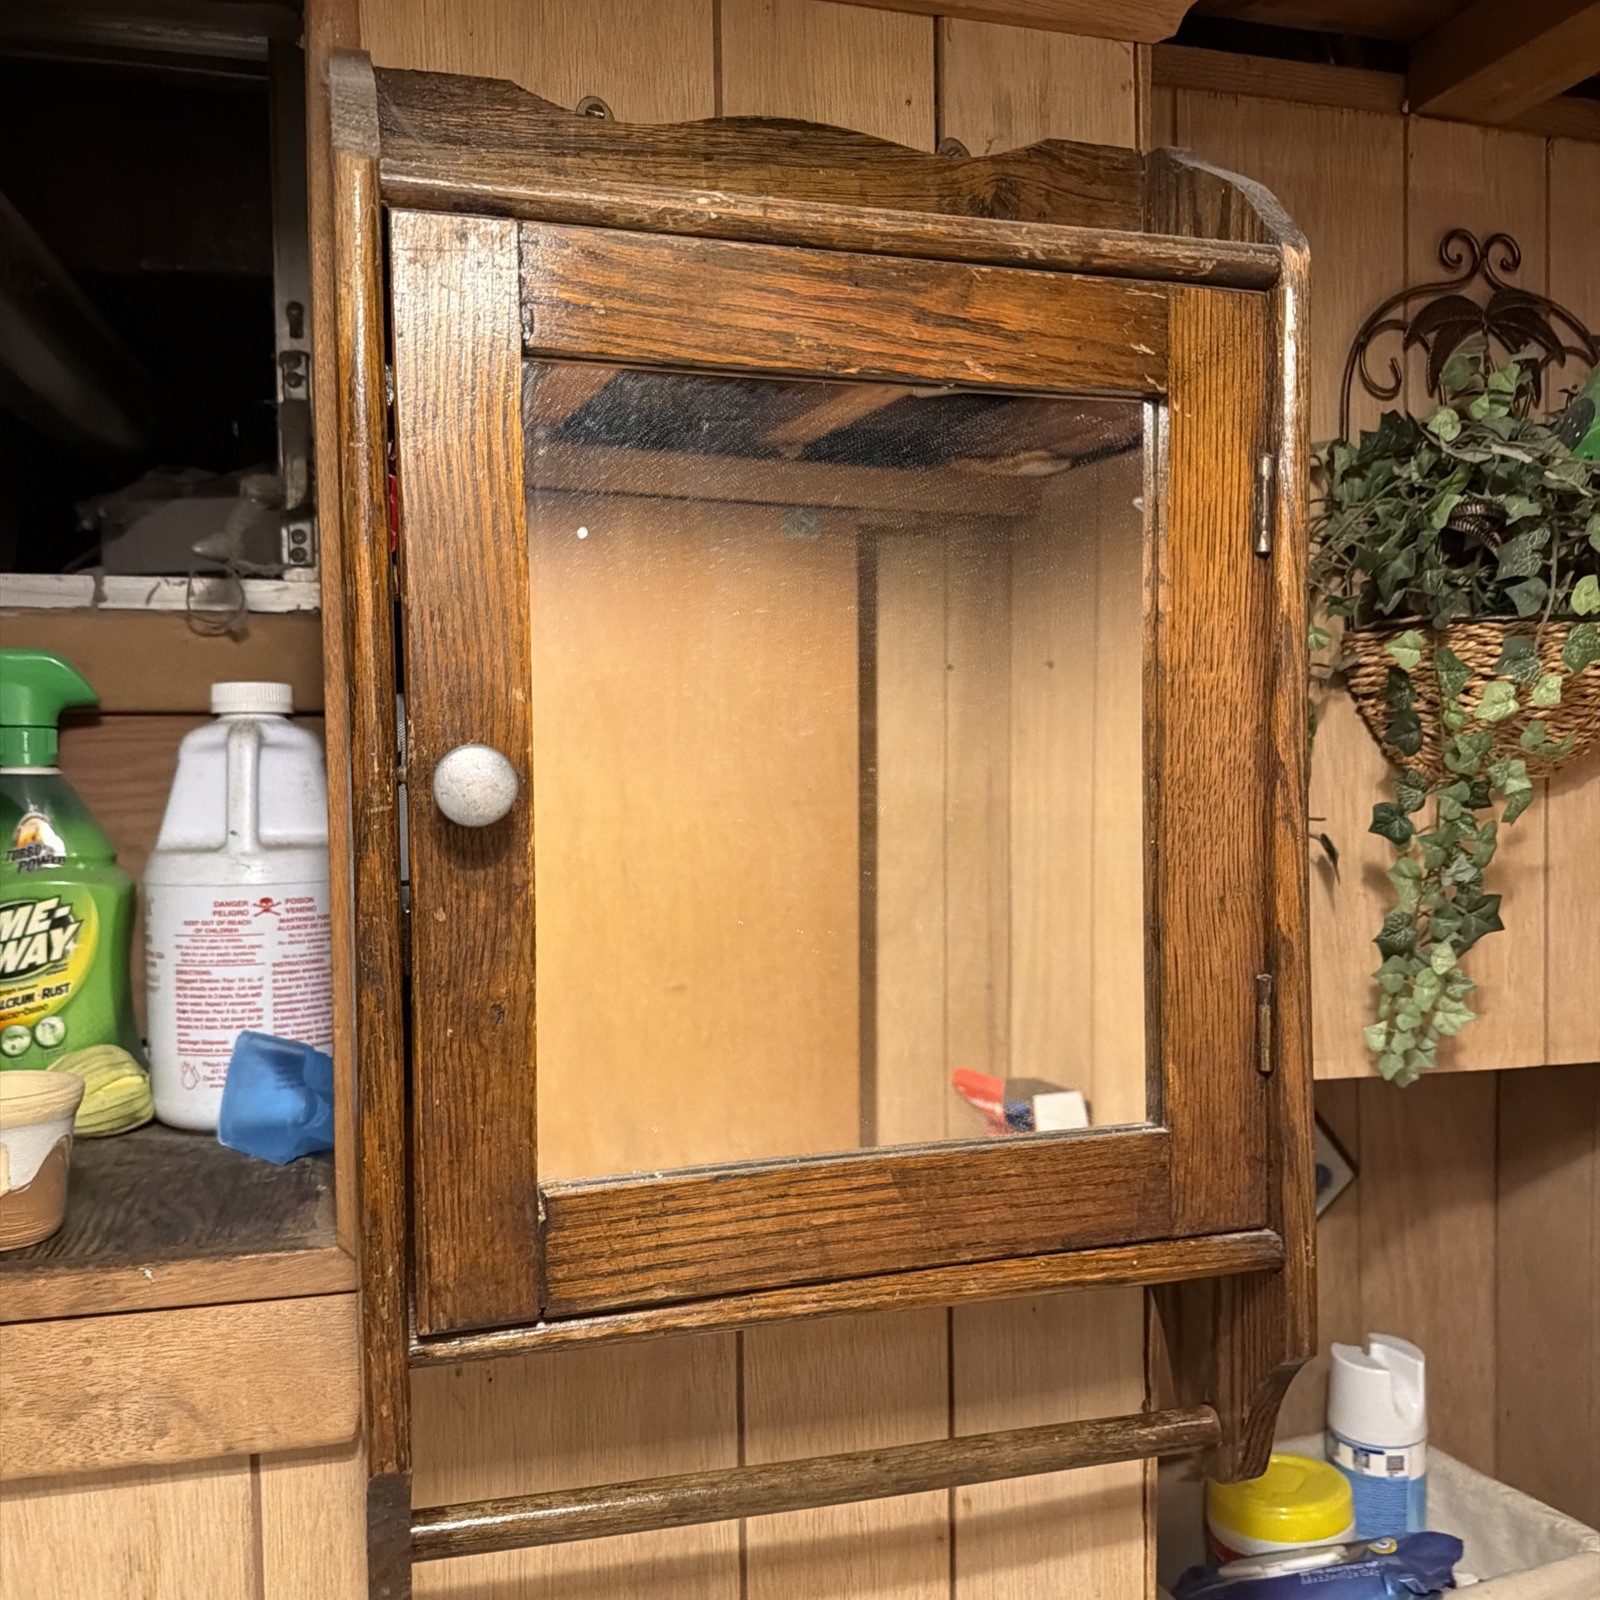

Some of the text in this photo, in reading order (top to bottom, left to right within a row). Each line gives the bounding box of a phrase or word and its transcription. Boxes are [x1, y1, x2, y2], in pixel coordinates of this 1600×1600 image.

[213, 900, 249, 908] DANGER
[285, 897, 315, 905] POISON
[212, 909, 249, 917] PELIGRO
[285, 905, 317, 914] VENENO
[0, 919, 84, 975] WAY
[41, 982, 71, 1000] RUST
